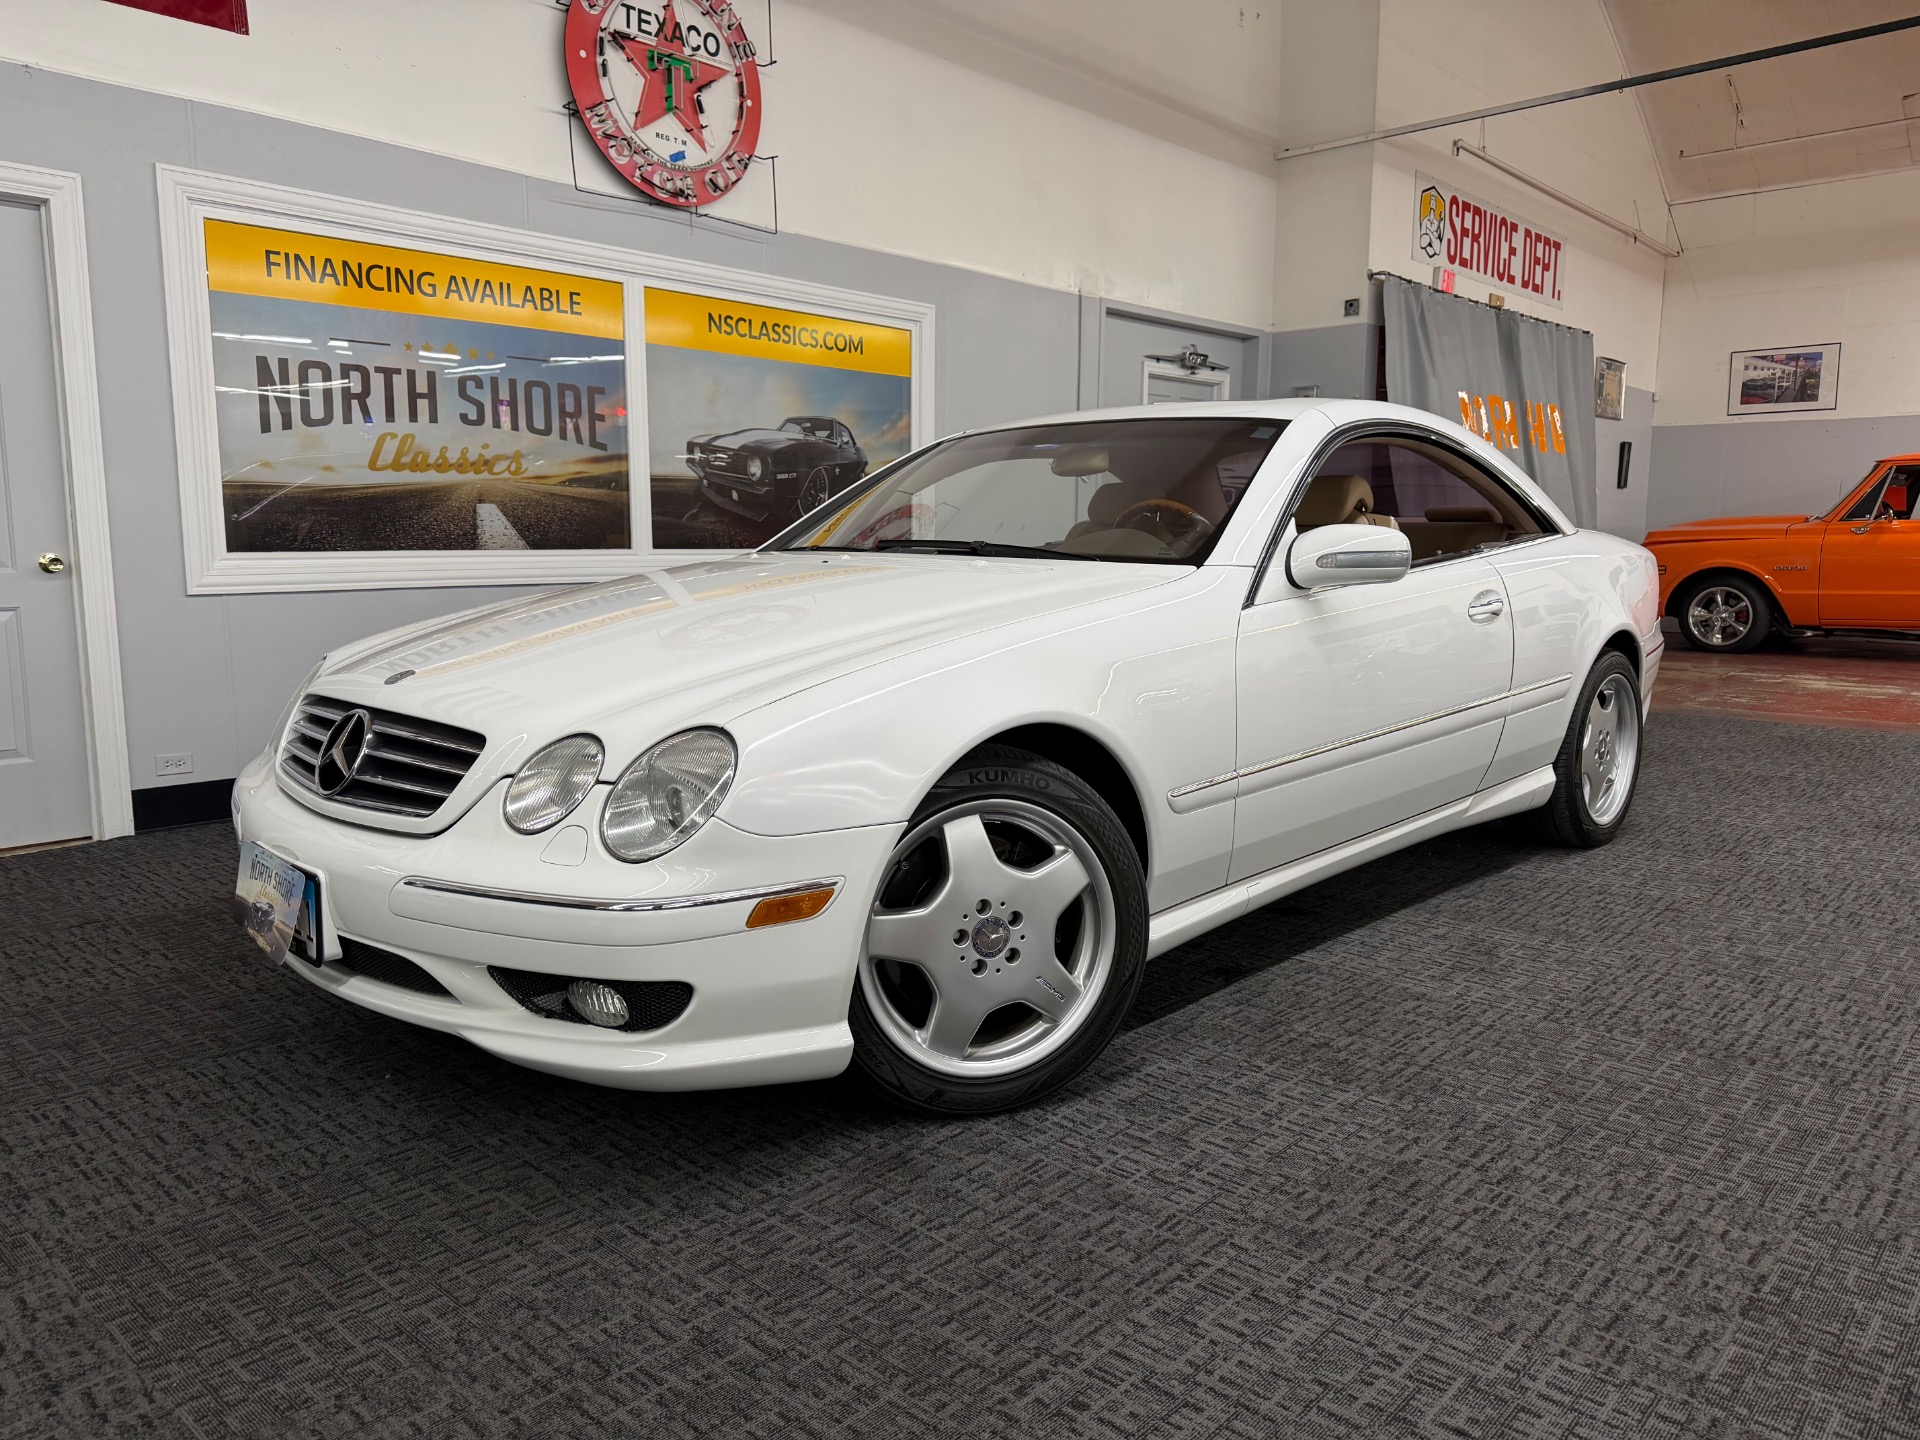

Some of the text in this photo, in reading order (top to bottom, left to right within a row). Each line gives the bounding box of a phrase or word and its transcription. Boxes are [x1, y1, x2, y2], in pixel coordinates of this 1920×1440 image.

[620, 2, 721, 57] TEXACO
[1446, 194, 1562, 301] SERVICE DEPT.
[264, 248, 583, 317] FINANCING AVAILABLE
[707, 311, 864, 356] NSCLASSICS.COM
[255, 354, 609, 452] NORTH SHORE
[367, 431, 530, 478] Classics
[968, 769, 1051, 790] KUMHO
[249, 857, 296, 908] NORTH SHORE
